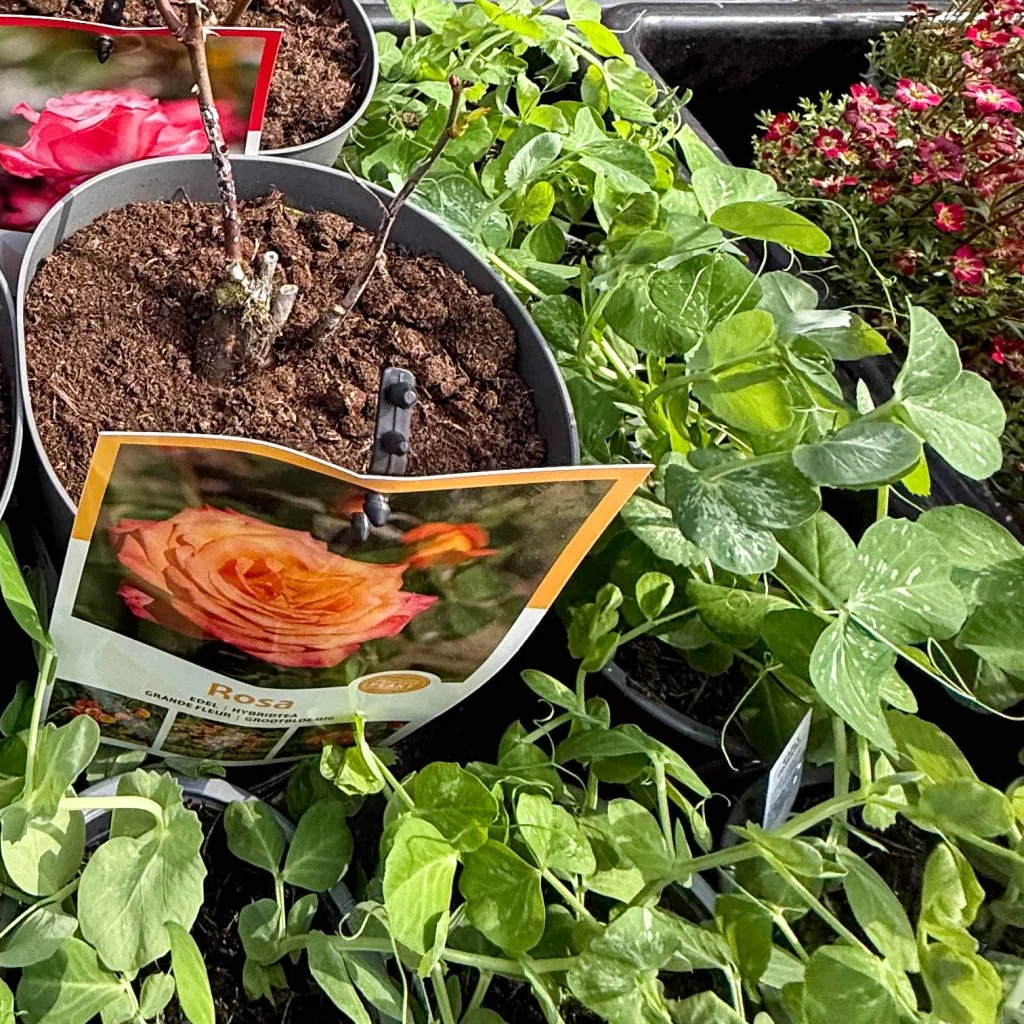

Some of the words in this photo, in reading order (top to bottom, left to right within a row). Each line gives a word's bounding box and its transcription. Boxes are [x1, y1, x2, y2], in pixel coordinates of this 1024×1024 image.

[144, 690, 193, 709] GRANDE
[194, 704, 231, 719] FLEUR
[189, 695, 218, 709] EDEL
[232, 707, 298, 719] HYBRIDTEA
[207, 682, 295, 710] Rosa
